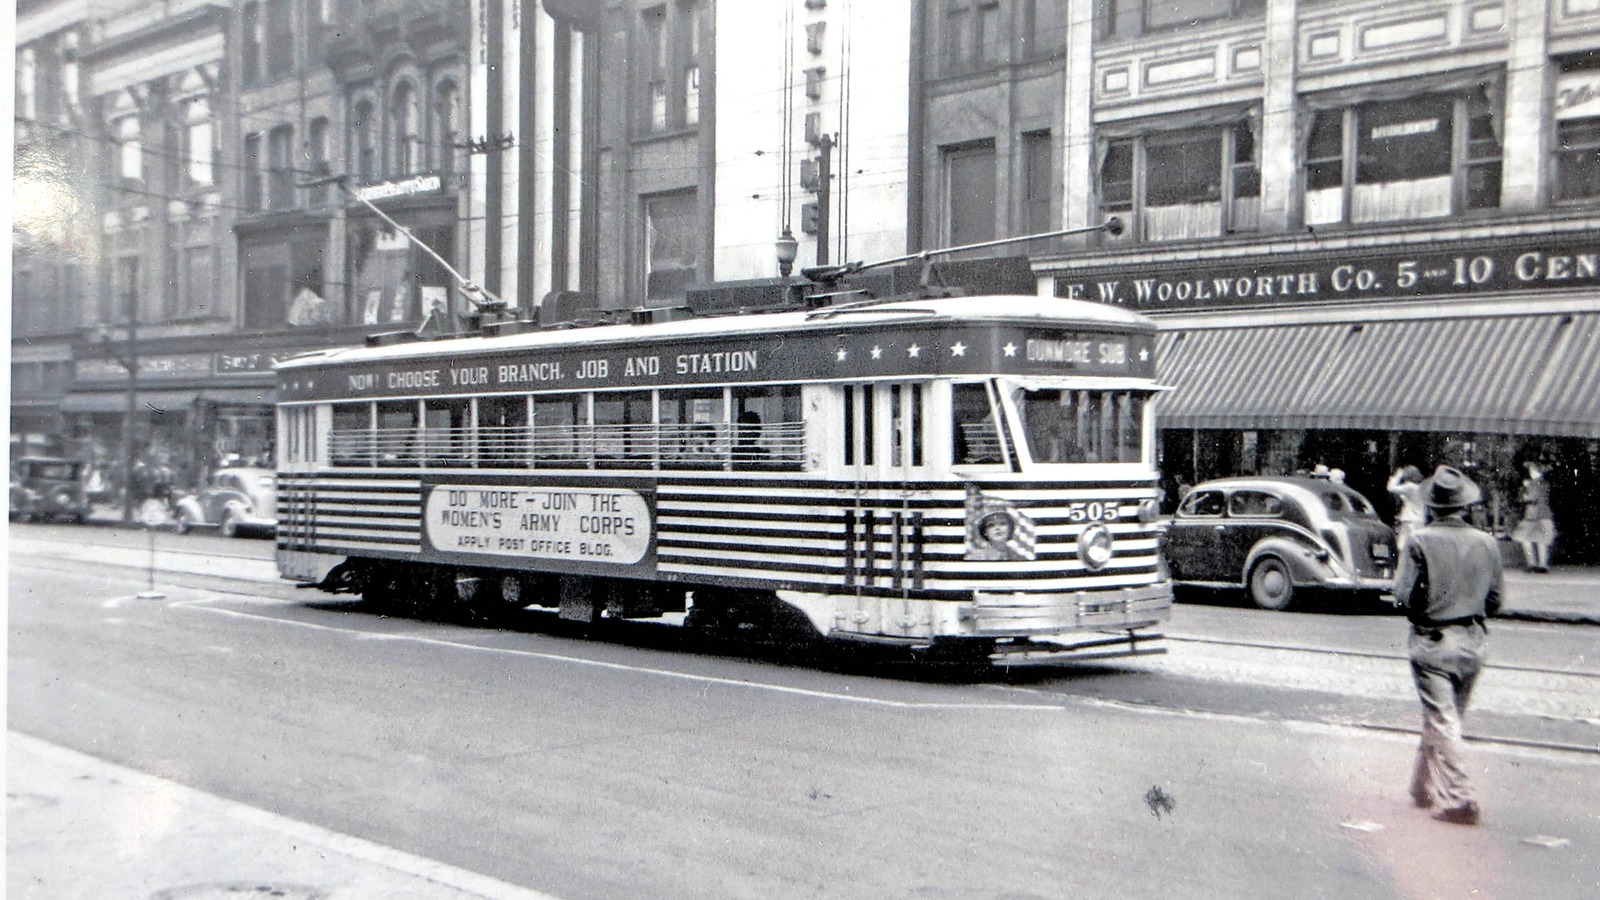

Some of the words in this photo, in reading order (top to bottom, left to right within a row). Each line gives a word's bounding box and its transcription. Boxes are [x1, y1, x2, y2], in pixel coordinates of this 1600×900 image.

[1098, 281, 1123, 304] W.
[1133, 272, 1319, 304] WOOLWORTH
[1397, 261, 1418, 288] 5
[1453, 255, 1494, 285] 10
[349, 375, 380, 391] NOW!
[388, 370, 440, 389] CHOOSE
[450, 366, 489, 386] YOUR
[576, 359, 609, 379] JOB
[624, 356, 660, 377] AND
[676, 350, 758, 375] STATION
[450, 490, 467, 507] DO
[480, 491, 519, 510] MORE
[542, 492, 577, 511] JOIN
[591, 494, 622, 513] THE
[1069, 501, 1119, 521] 505
[442, 510, 502, 529] WOMEN'S
[519, 513, 562, 532] ARMY
[579, 515, 635, 536] CORPS
[457, 536, 490, 549] APPLY
[500, 538, 525, 551] POST
[531, 540, 572, 554] OFFICE
[579, 543, 614, 557] BLDG.
